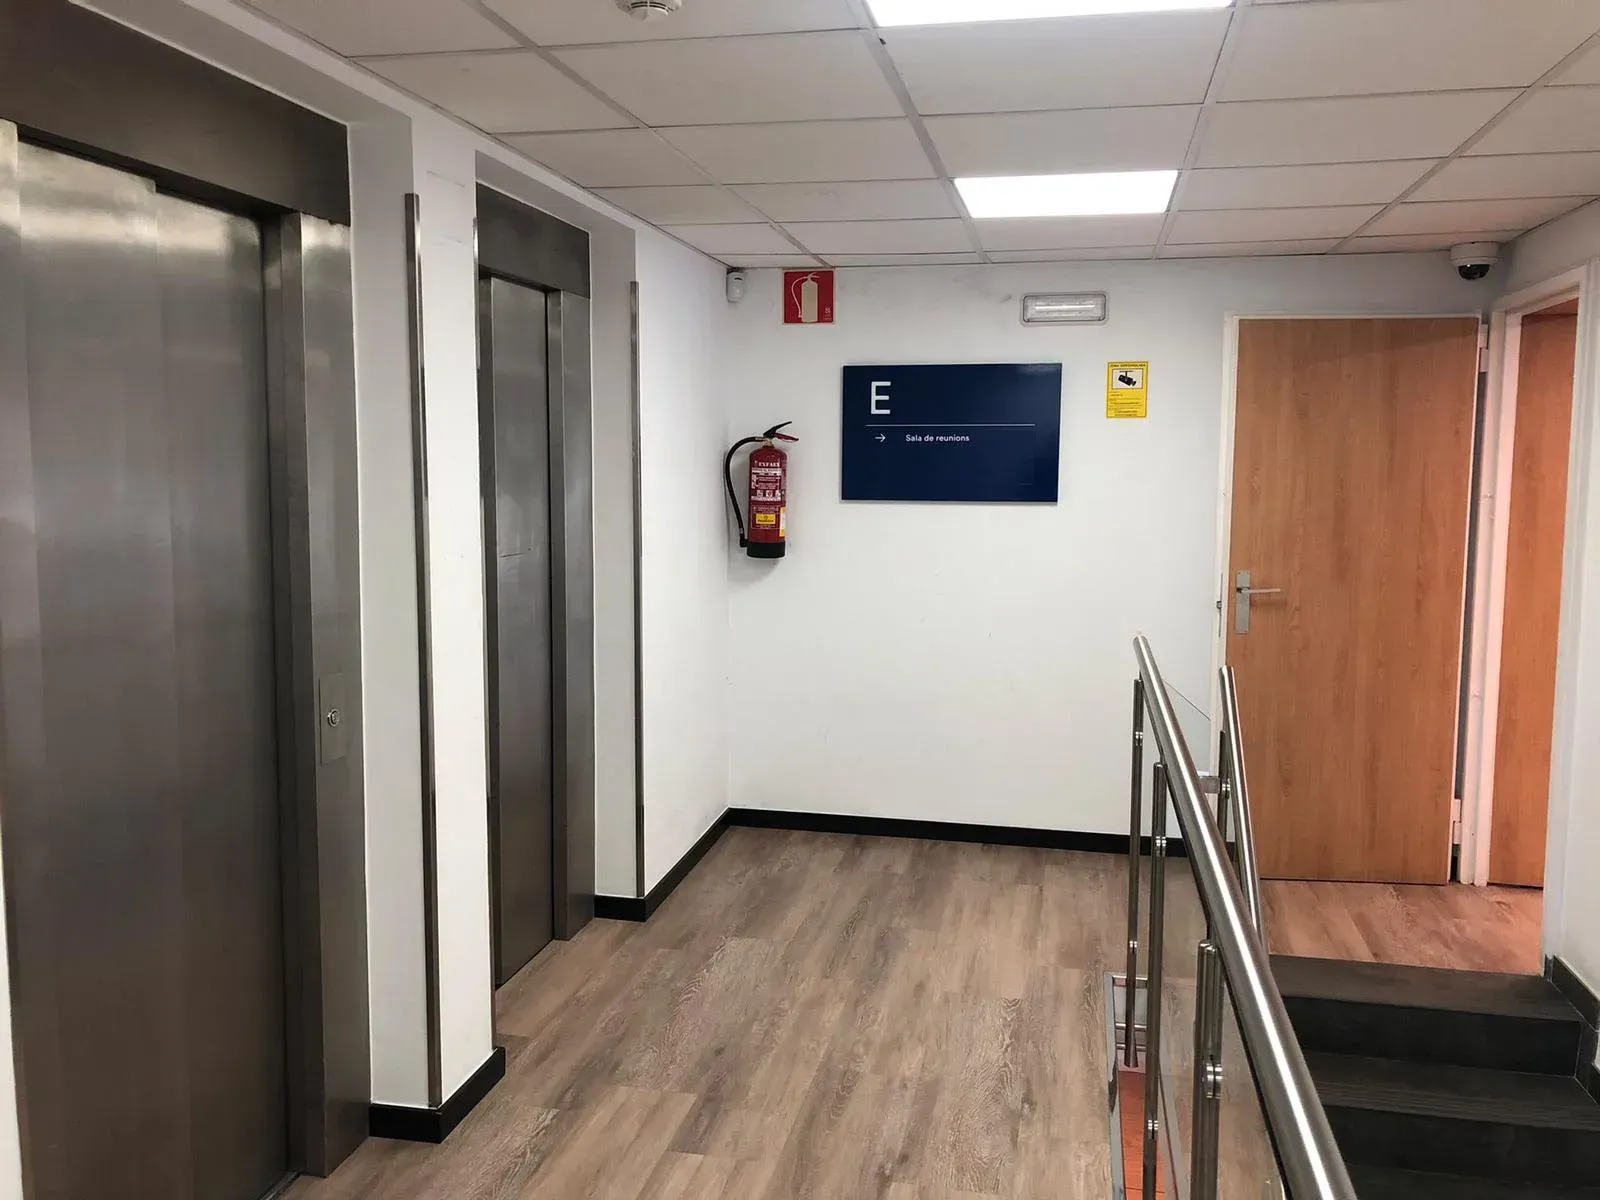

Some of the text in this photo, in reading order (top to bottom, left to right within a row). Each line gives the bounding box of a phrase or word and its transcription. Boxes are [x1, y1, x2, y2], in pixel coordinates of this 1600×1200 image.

[870, 381, 892, 415] E
[905, 434, 970, 443] Sala de reunions
